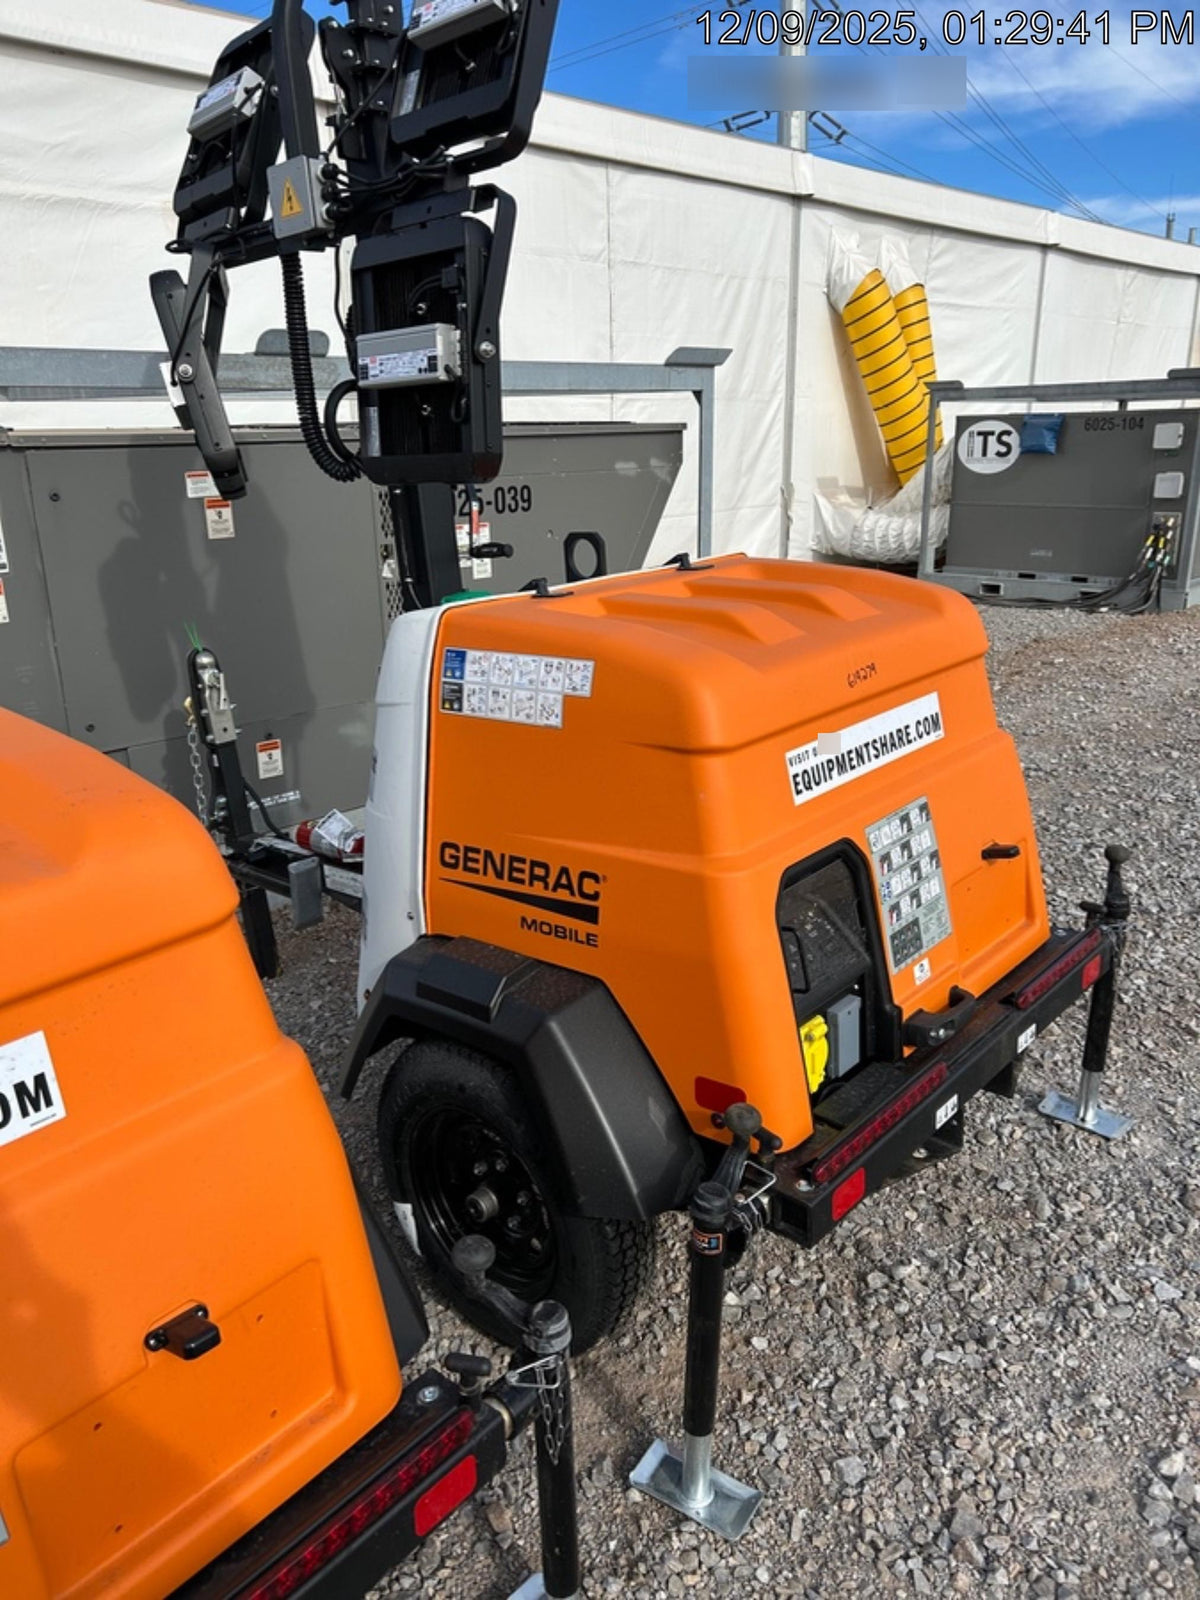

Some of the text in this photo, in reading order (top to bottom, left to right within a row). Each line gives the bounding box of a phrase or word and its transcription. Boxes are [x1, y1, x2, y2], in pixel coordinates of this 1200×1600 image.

[1084, 416, 1145, 432] 6025-104
[788, 749, 809, 767] VISIT
[792, 711, 942, 796] EQUIPMENTSHARE.COM
[439, 841, 601, 902] GENERAC
[520, 915, 599, 948] MOBILE
